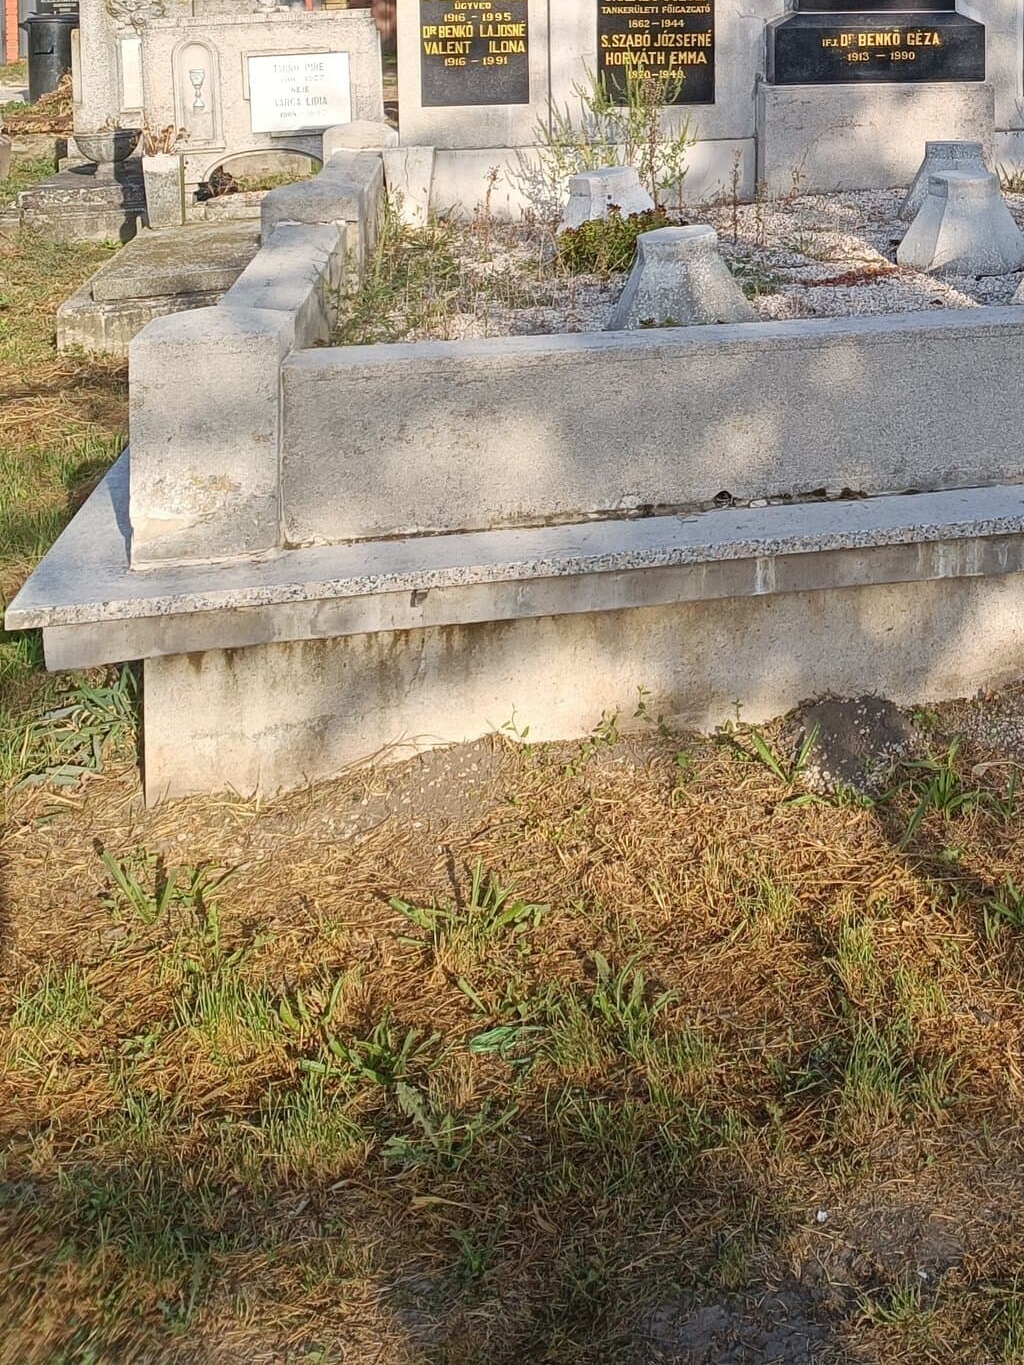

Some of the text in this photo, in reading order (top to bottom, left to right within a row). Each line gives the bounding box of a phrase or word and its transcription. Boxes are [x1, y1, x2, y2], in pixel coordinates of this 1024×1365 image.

[601, 5, 659, 14] TANKERÜLETI
[444, 13, 466, 22] 1916
[482, 12, 512, 21] 1995
[480, 20, 526, 37] LAJOSNÉ
[653, 29, 712, 47] JÓZSEFNÉ
[907, 30, 940, 46] GÉZA
[424, 40, 526, 54] VALENT ILONA
[444, 57, 466, 66] 1916
[483, 56, 508, 65] 1991
[605, 48, 707, 66] HORVÁTH EMMA
[847, 53, 870, 61] 1913
[890, 51, 915, 60] 1990
